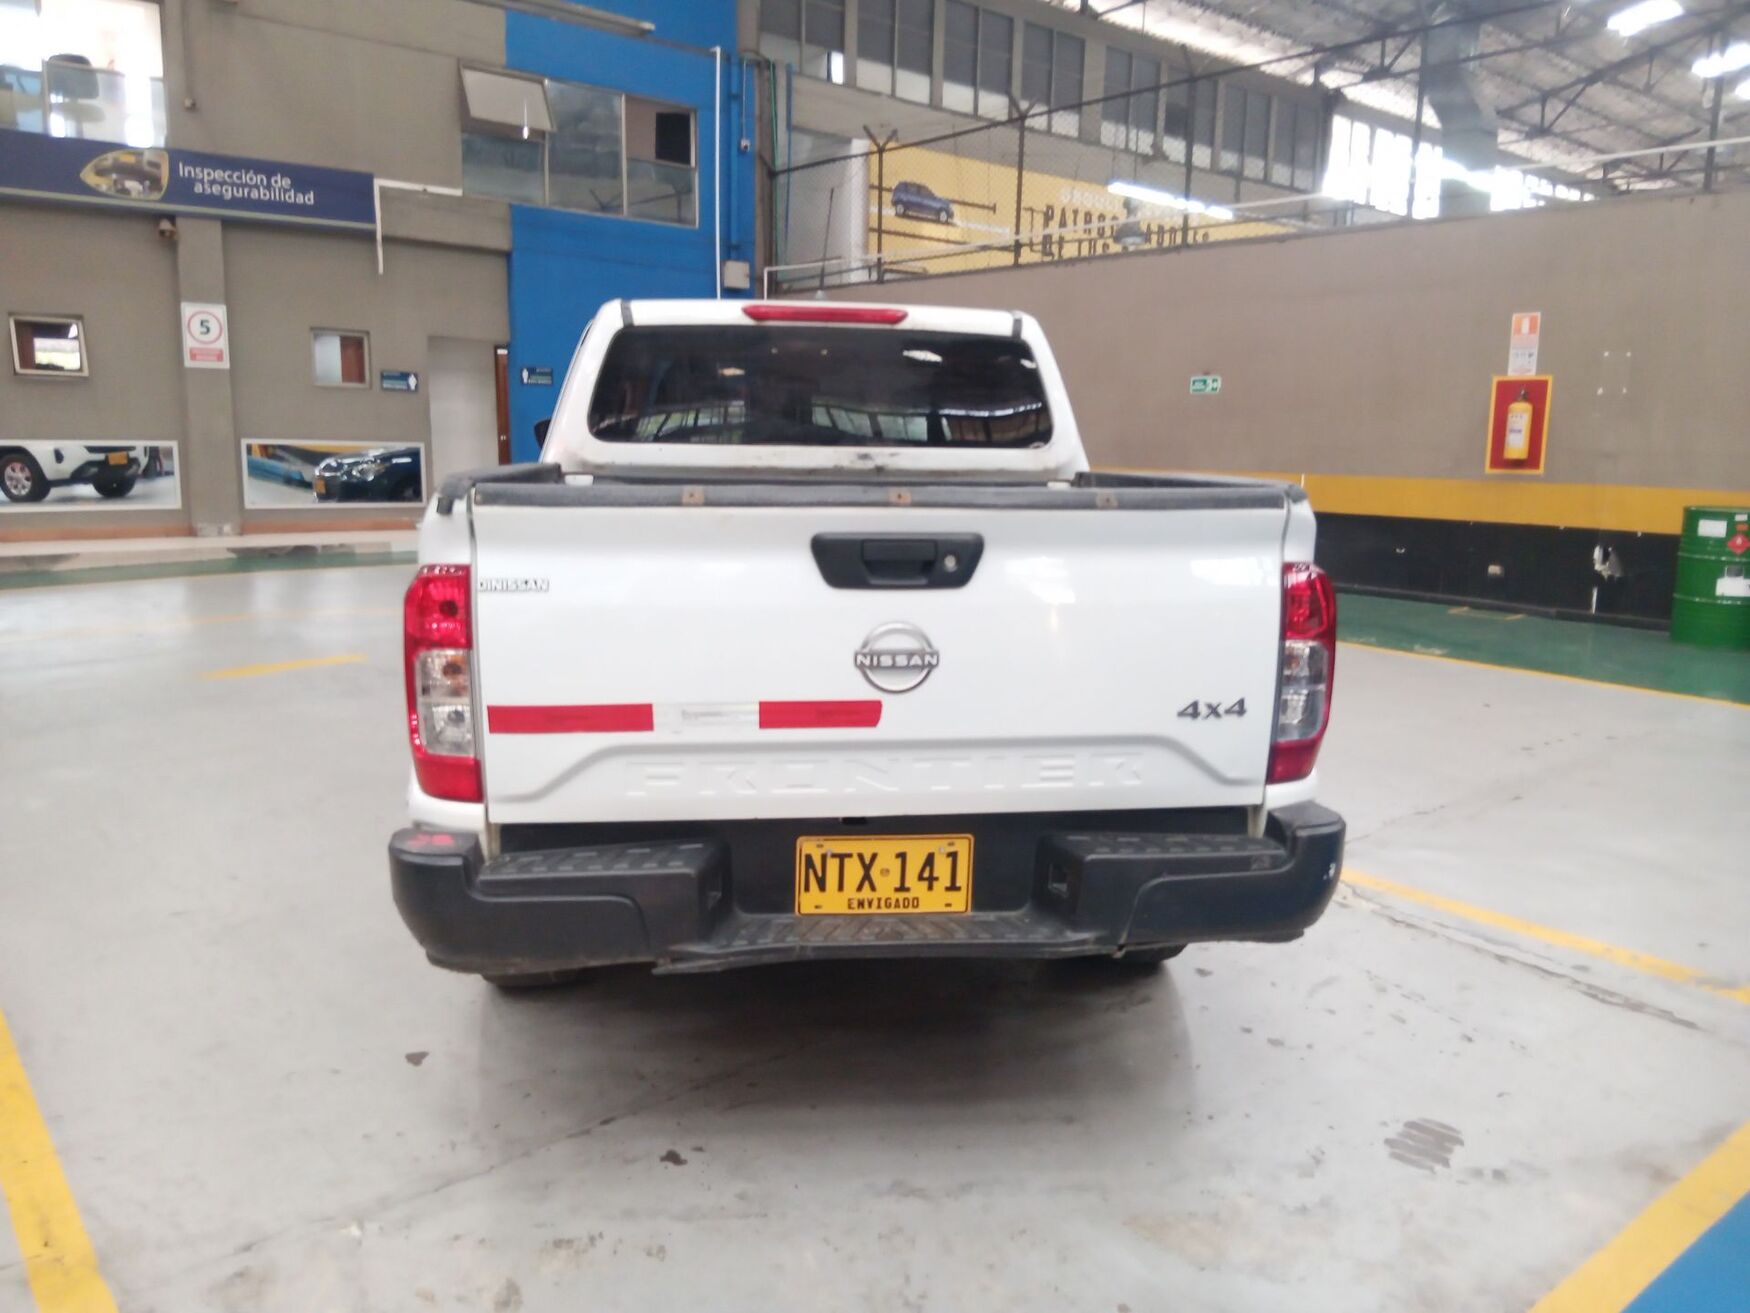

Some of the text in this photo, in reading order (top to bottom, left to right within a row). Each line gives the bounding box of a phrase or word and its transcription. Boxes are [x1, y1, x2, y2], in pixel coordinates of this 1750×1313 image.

[178, 161, 292, 189] Inspección de
[193, 182, 315, 206] asegurabilidad
[200, 319, 211, 336] 5
[478, 578, 550, 592] DINISSAN
[855, 653, 938, 668] NISSAN
[804, 851, 962, 893] NTX 141
[847, 896, 920, 910] ENVIGADO
